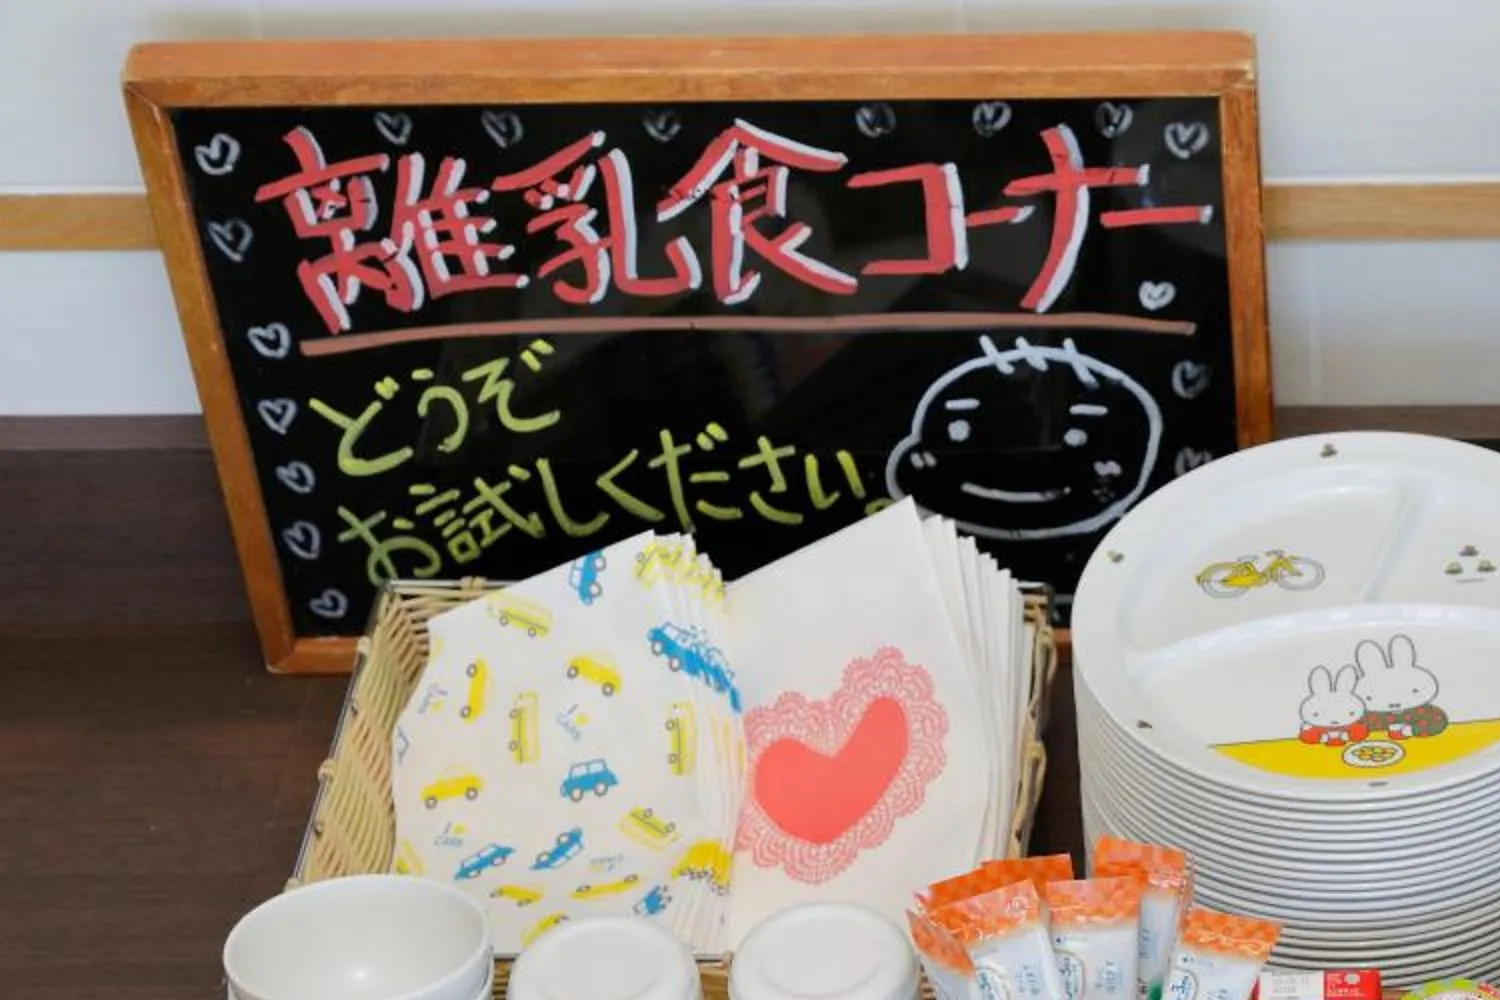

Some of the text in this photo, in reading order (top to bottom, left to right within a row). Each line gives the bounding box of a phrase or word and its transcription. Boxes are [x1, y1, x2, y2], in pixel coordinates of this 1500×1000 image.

[255, 120, 1214, 335] 離乳食コーナー
[309, 338, 560, 477] どうぞ
